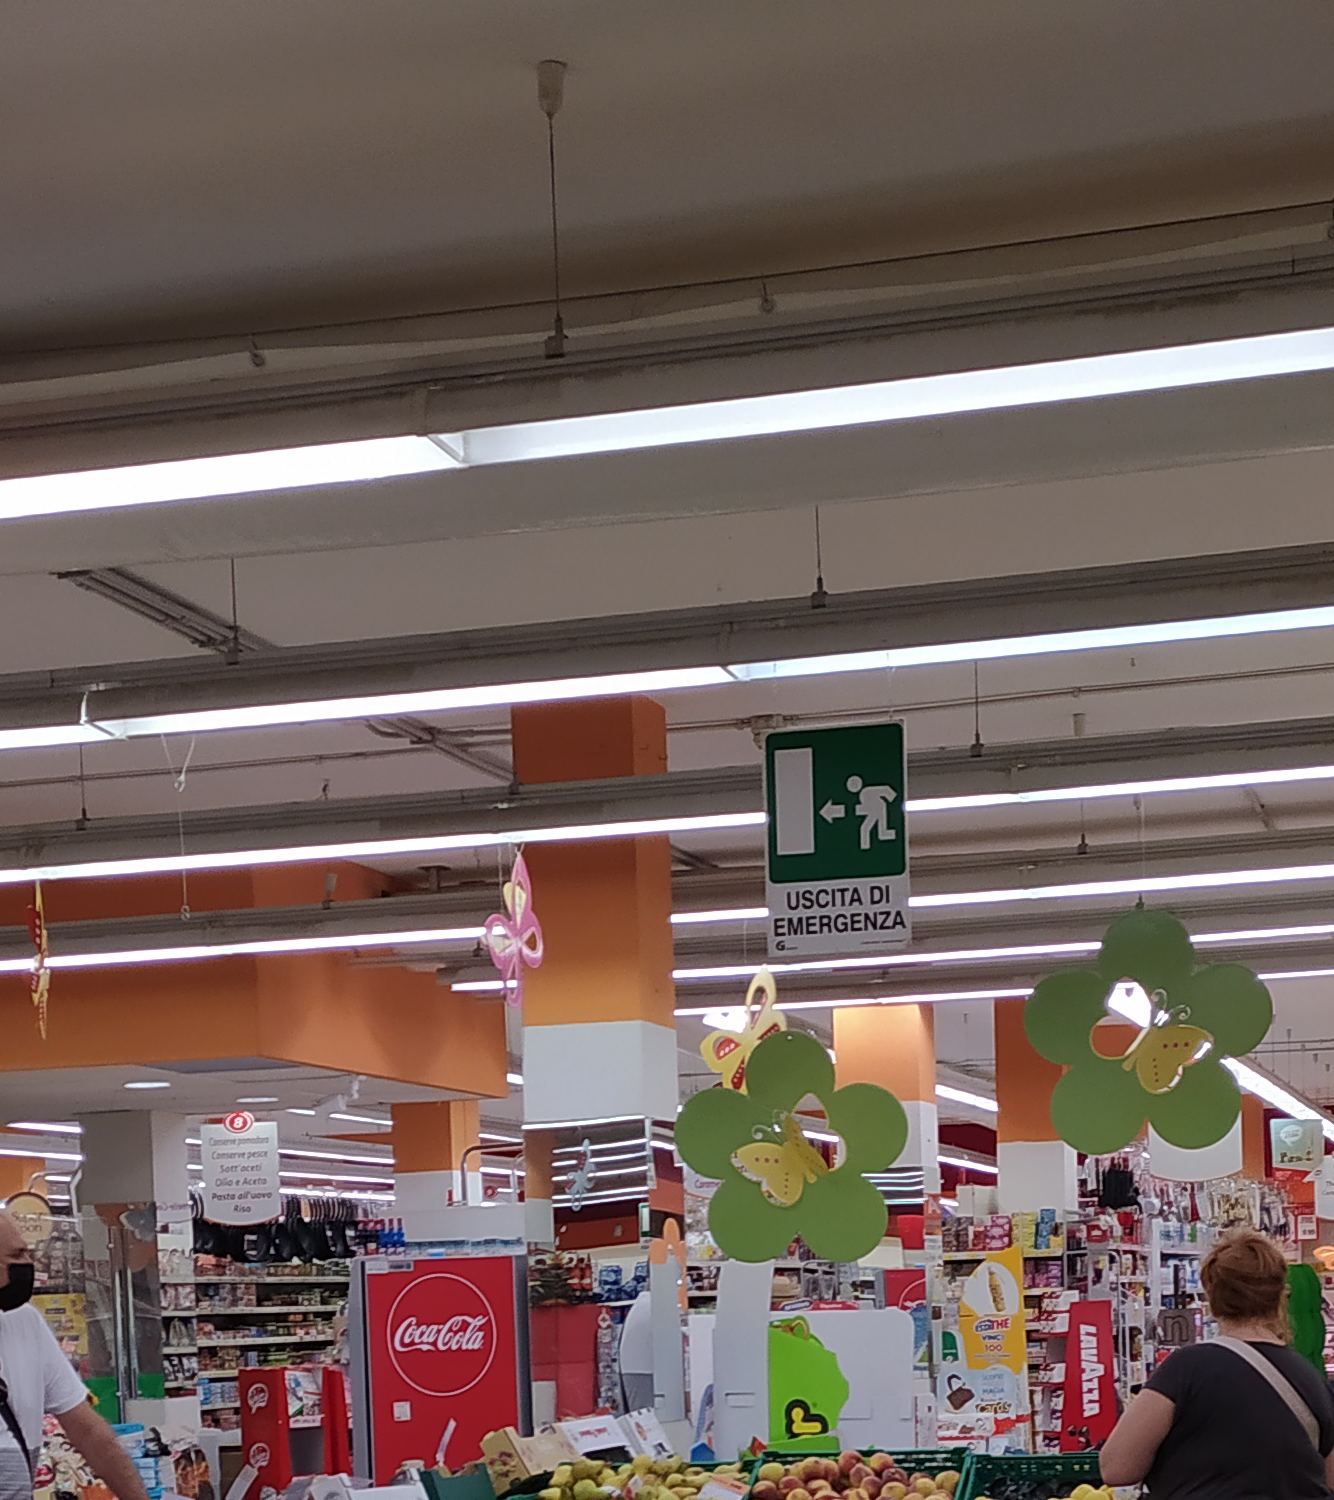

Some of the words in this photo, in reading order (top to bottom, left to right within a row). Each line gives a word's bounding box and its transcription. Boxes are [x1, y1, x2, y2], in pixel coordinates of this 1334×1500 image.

[786, 886, 864, 911] USCITA
[870, 885, 891, 905] DI
[773, 911, 906, 937] EMERGENZA
[233, 1116, 244, 1128] 8
[233, 1204, 252, 1213] Riso
[393, 1315, 490, 1352] Coca-Cola
[1079, 1323, 1106, 1418] LAVAZZA
